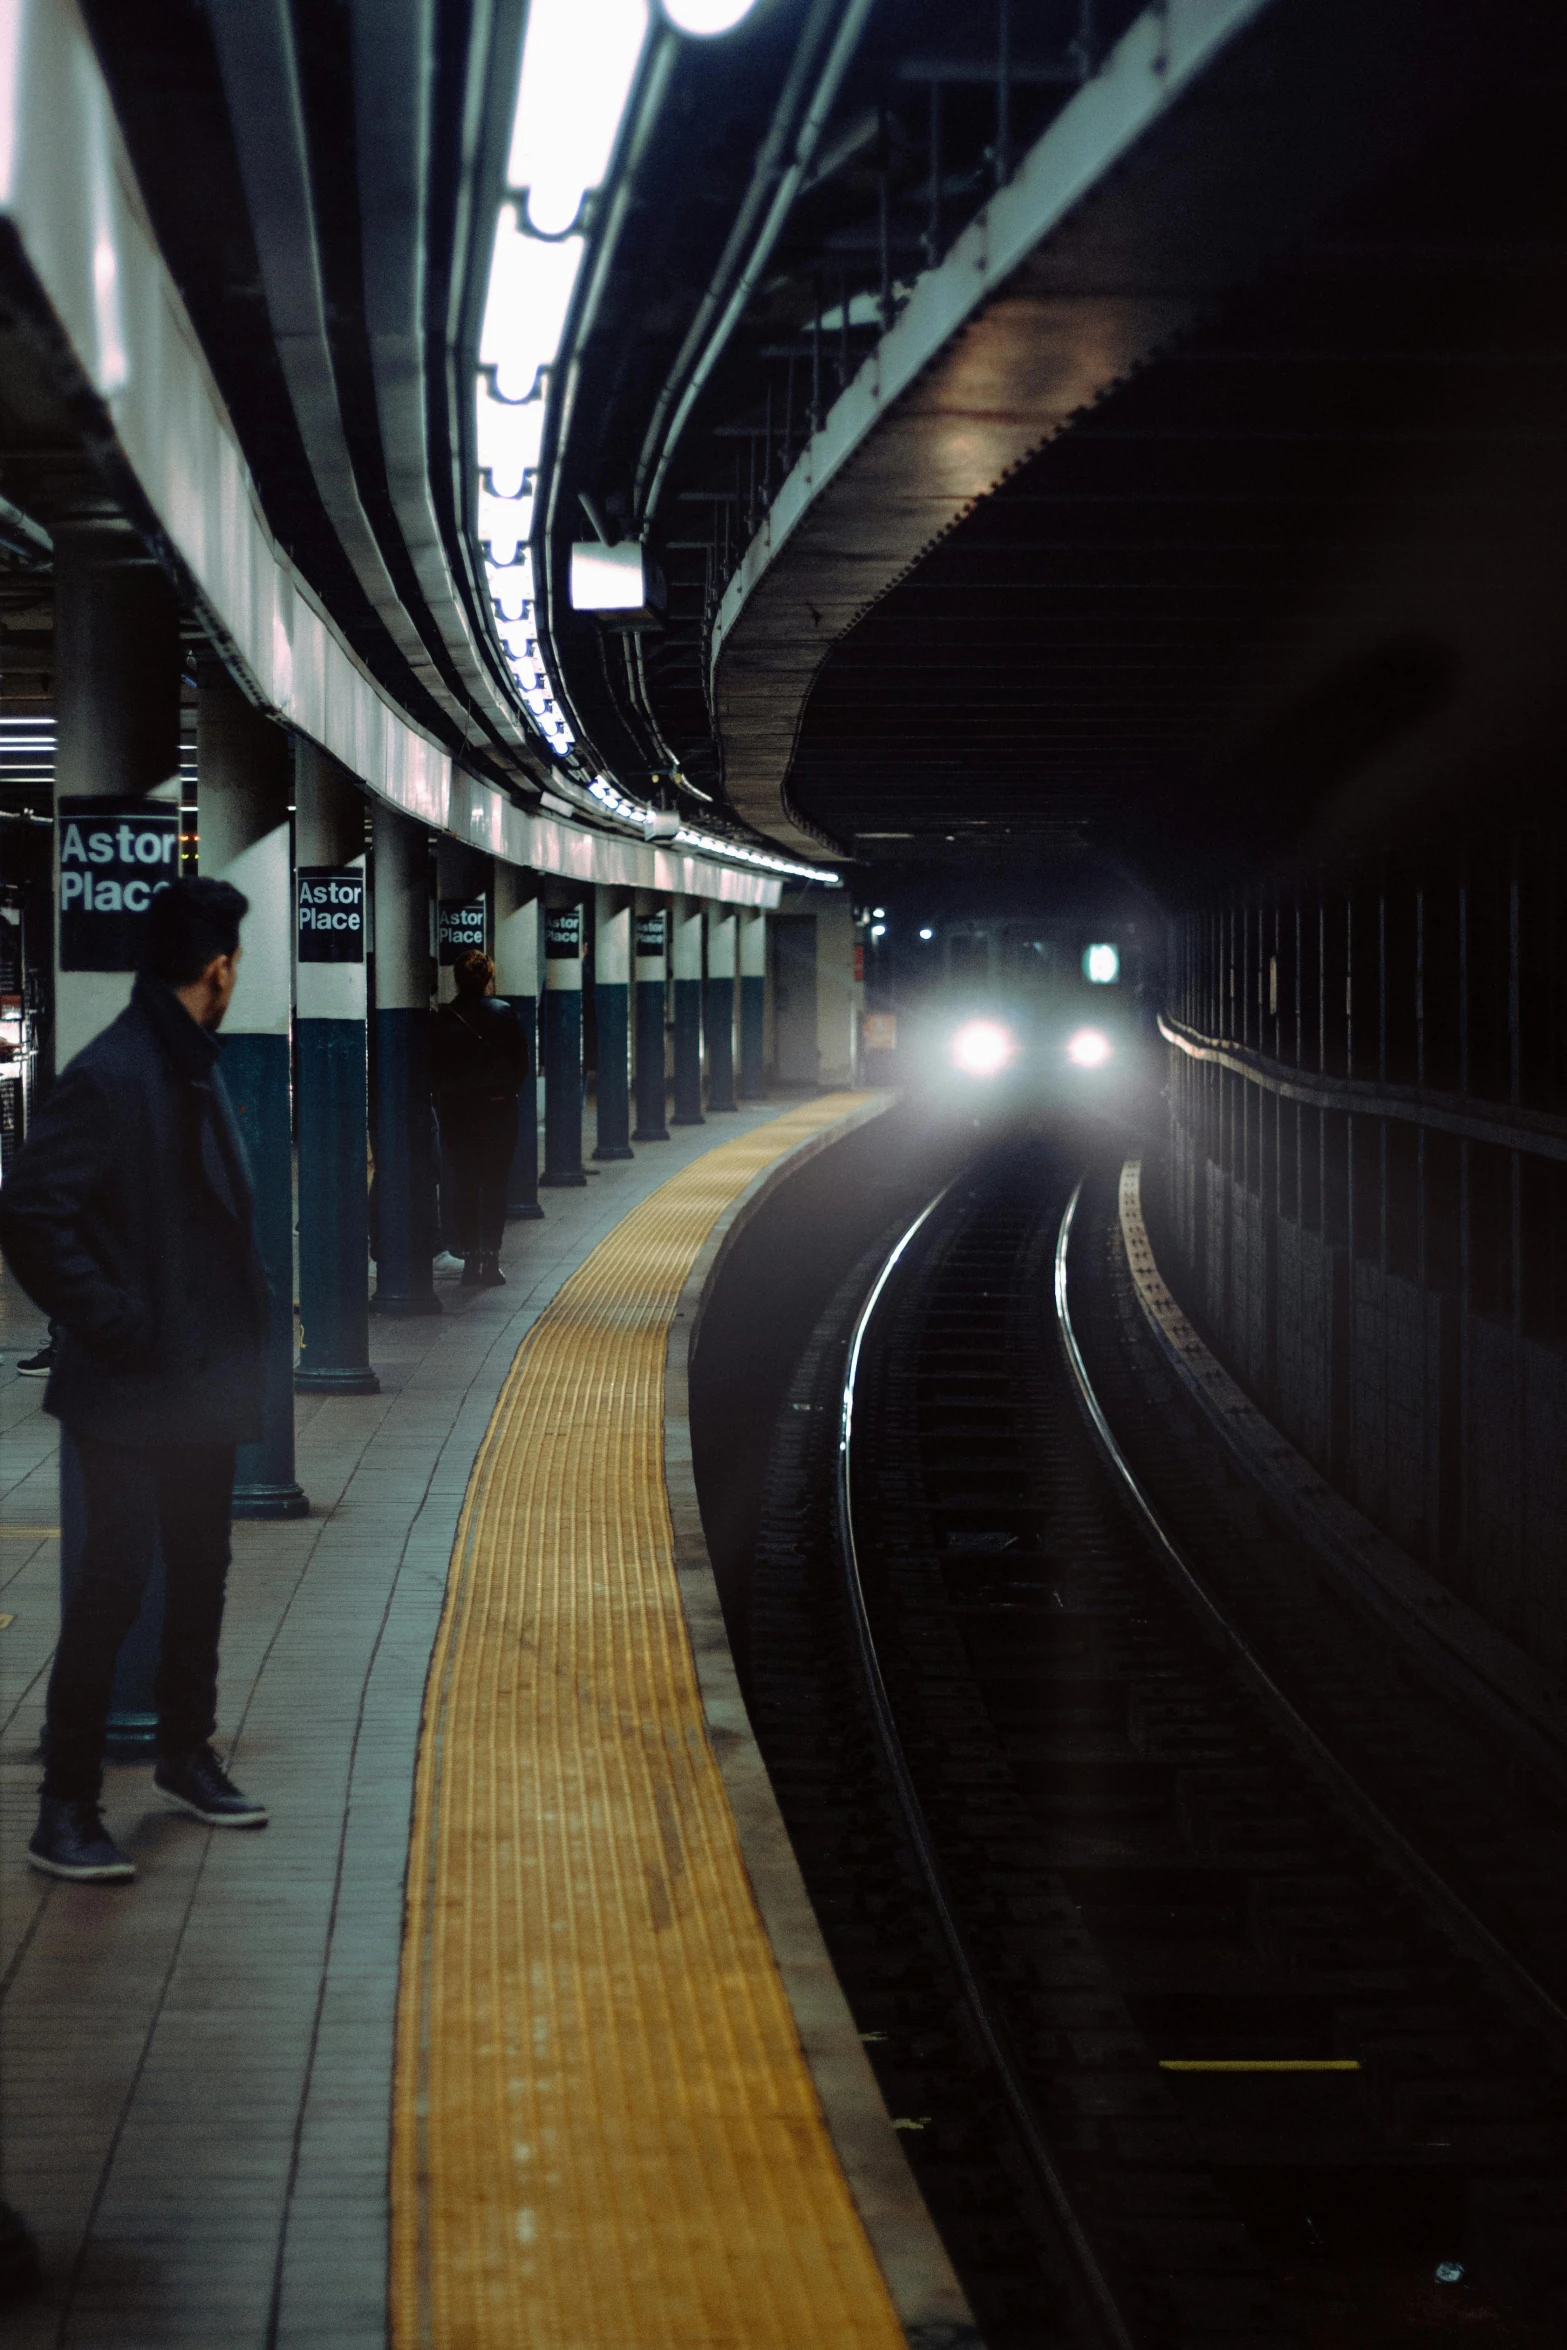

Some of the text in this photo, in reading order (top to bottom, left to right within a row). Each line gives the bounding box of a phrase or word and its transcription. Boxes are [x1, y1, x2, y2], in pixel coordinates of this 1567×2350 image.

[61, 823, 176, 864] Astor
[61, 871, 171, 912] Plac
[299, 882, 361, 904] Astor
[299, 907, 361, 930] Place
[440, 910, 482, 925] Astor
[440, 927, 482, 944] Place
